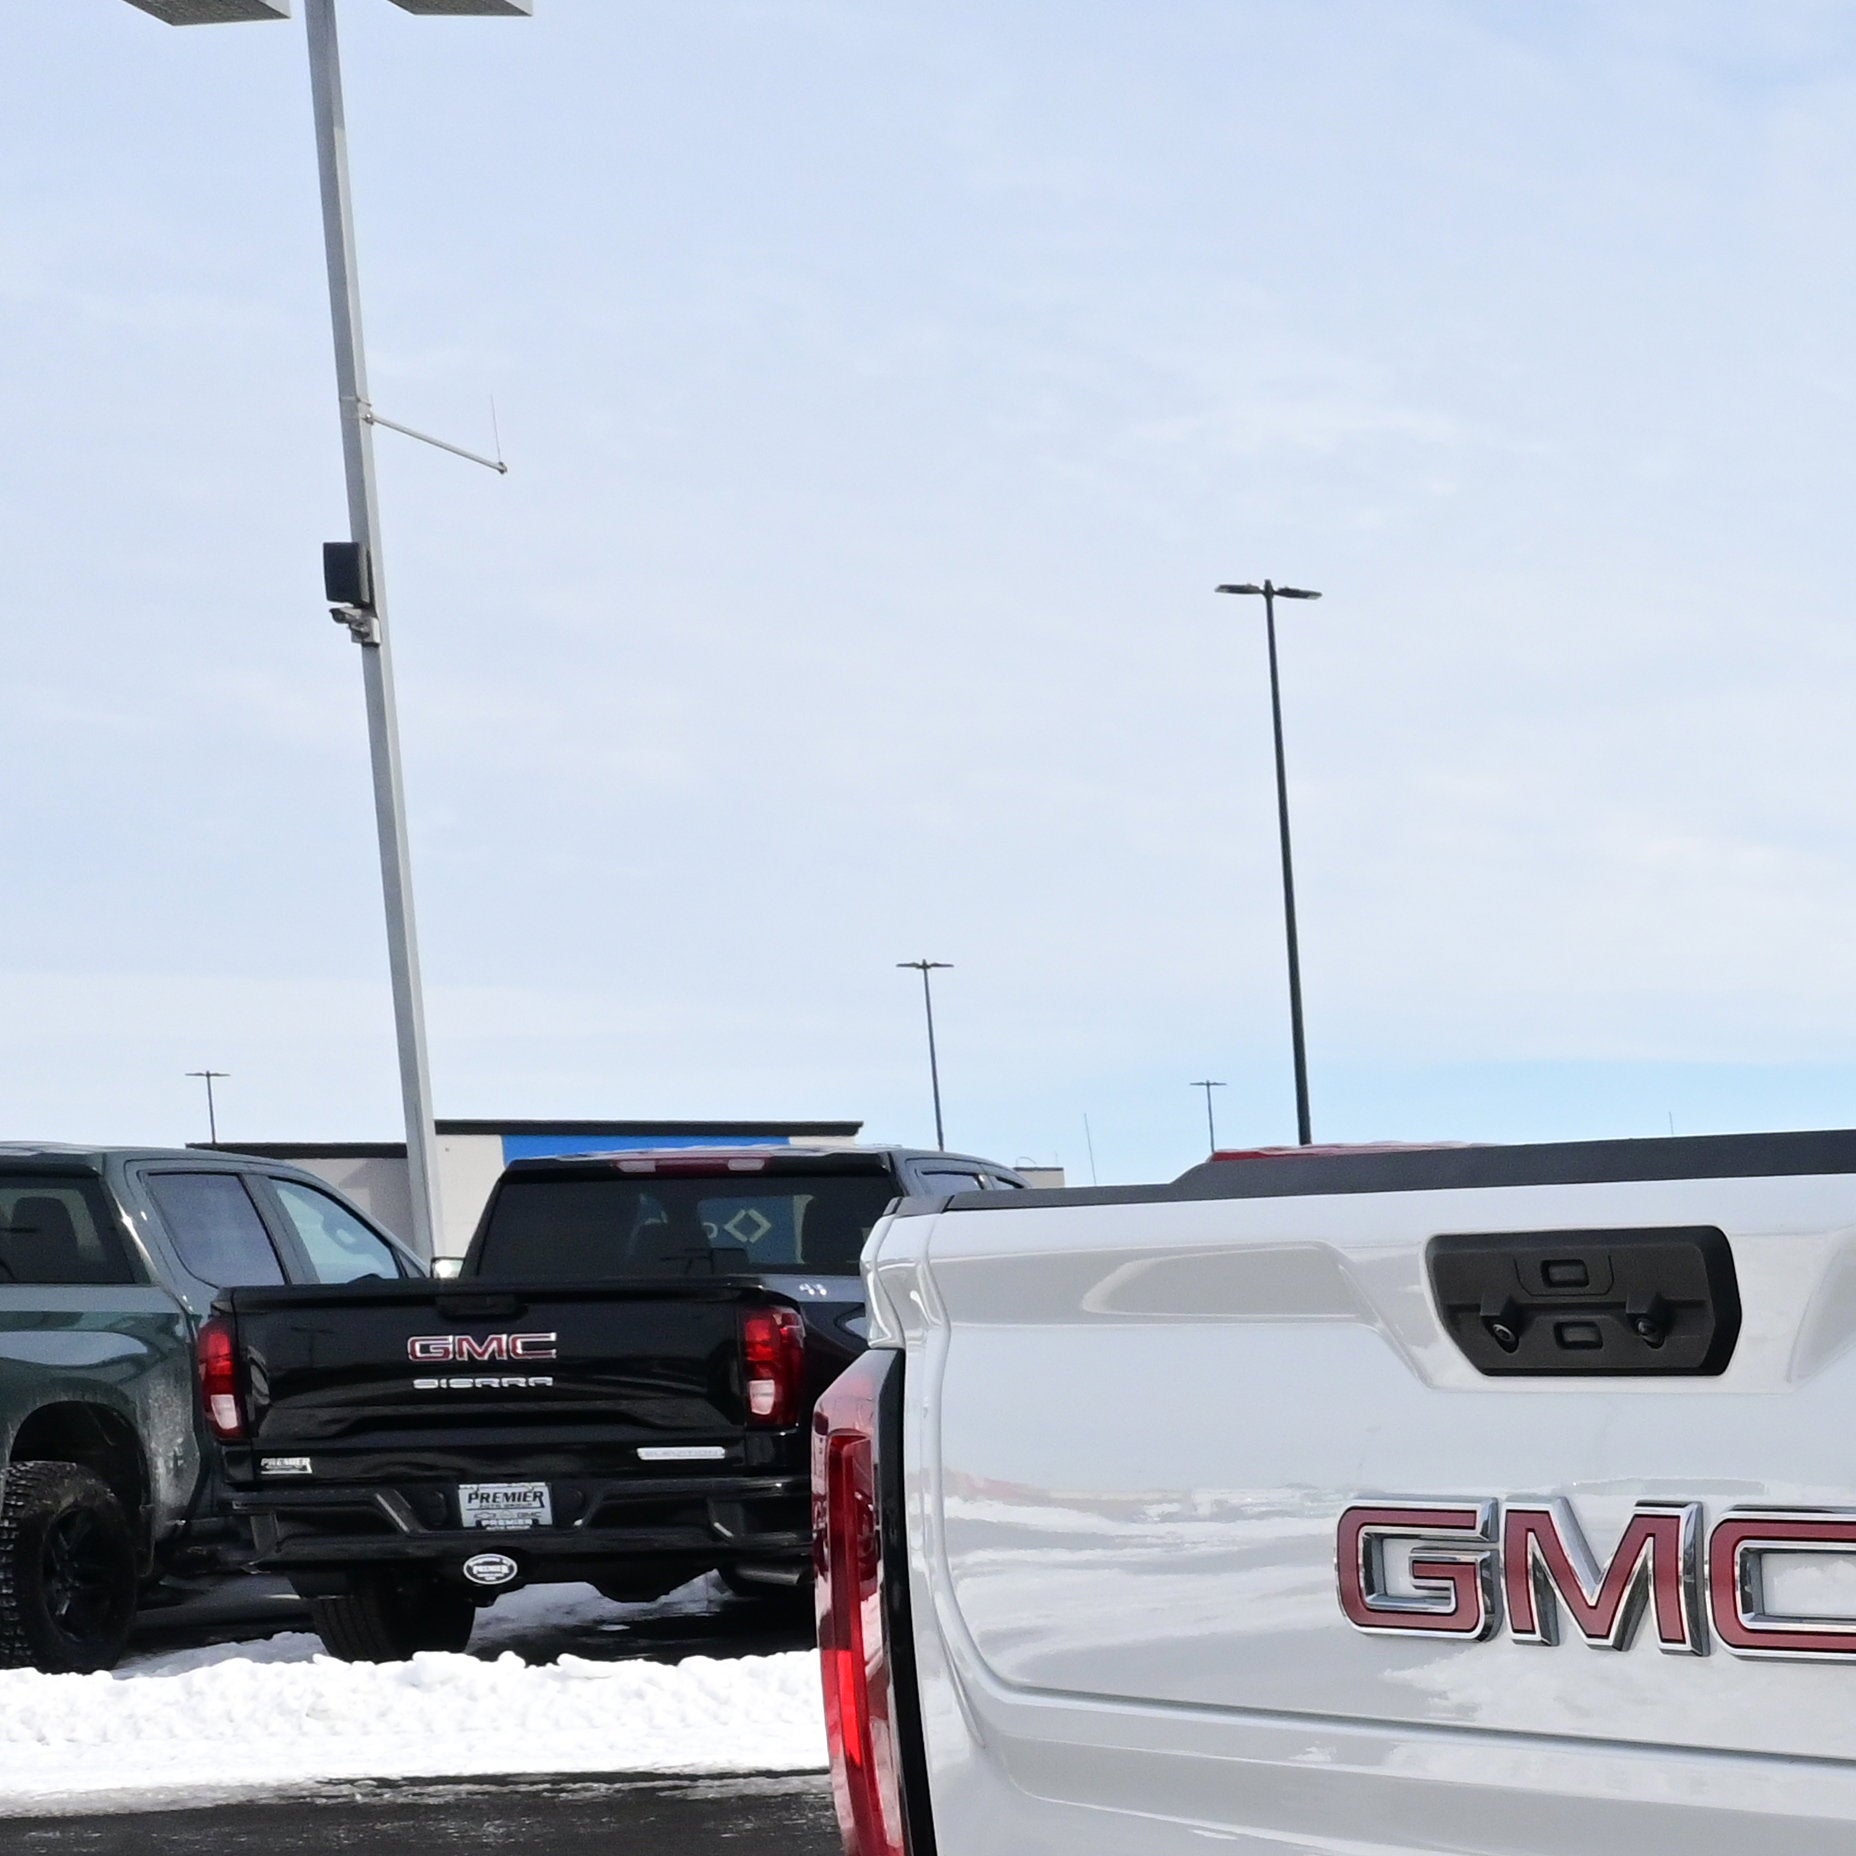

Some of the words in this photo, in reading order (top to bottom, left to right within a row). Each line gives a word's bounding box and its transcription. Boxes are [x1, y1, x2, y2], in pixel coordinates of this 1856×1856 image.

[408, 1332, 557, 1361] GMC
[413, 1377, 553, 1389] SIERRA
[467, 1490, 544, 1505] PREMIER
